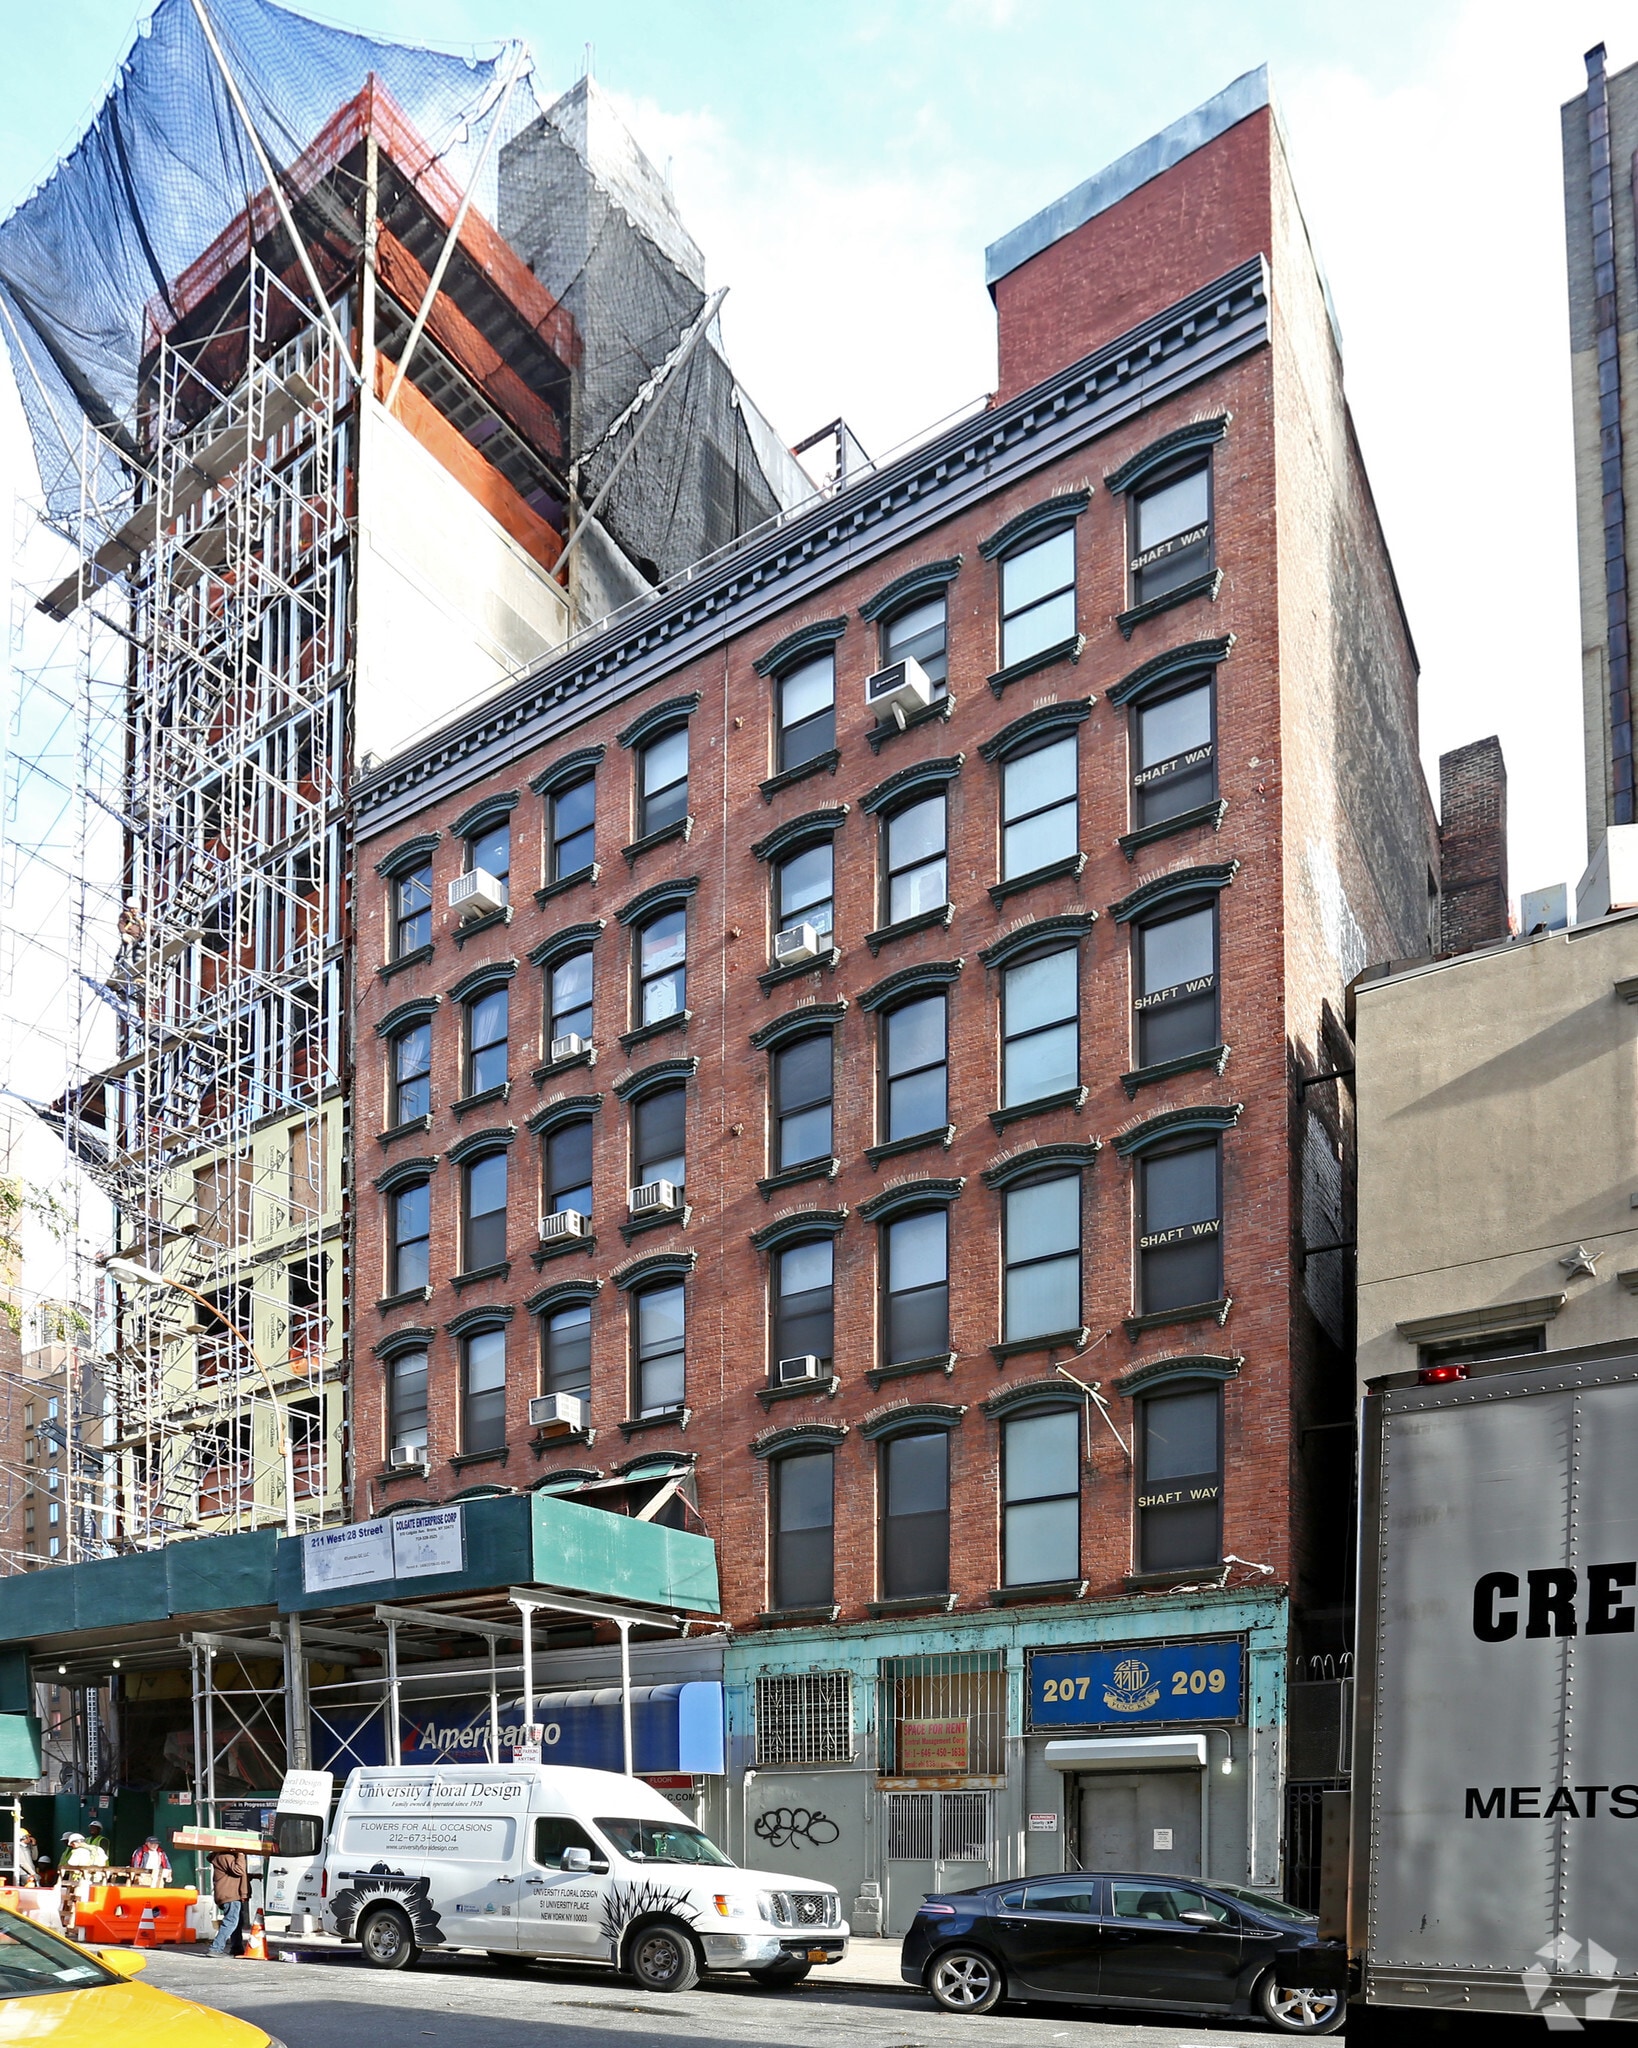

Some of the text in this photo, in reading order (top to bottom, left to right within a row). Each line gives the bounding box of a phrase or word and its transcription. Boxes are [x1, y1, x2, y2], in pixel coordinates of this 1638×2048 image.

[1130, 525, 1209, 571] SHAFT WAY
[1134, 745, 1213, 786] SHAFT WAY
[1134, 975, 1214, 1010] SHAFT WAY
[1140, 1219, 1220, 1248] SHAFT WAY
[1138, 1486, 1218, 1507] SHAFT WAY
[395, 1511, 457, 1531] COLGATE ENTERPRISE CORP
[311, 1524, 384, 1548] 211 West 28 Street
[1472, 1561, 1637, 1643] CRE
[1043, 1676, 1091, 1703] 207
[1171, 1668, 1226, 1696] 209
[1111, 1702, 1134, 1710] YUNG
[904, 1722, 967, 1736] SPACE FOR RENT
[358, 1782, 522, 1801] University Floral Design
[1464, 1784, 1638, 1820] MEATS
[360, 1822, 493, 1832] FLOWERS FOR ALL OCCASIONS
[388, 1834, 457, 1843] 212-673-5004
[533, 1888, 598, 1898] UNIVERSITY FLORAL DESIGN
[545, 1901, 573, 1909] UNIVERSITY
[573, 1901, 589, 1910] PLACE
[541, 1912, 552, 1920] NEW
[552, 1913, 565, 1921] YORK
[573, 1914, 588, 1922] 10003
